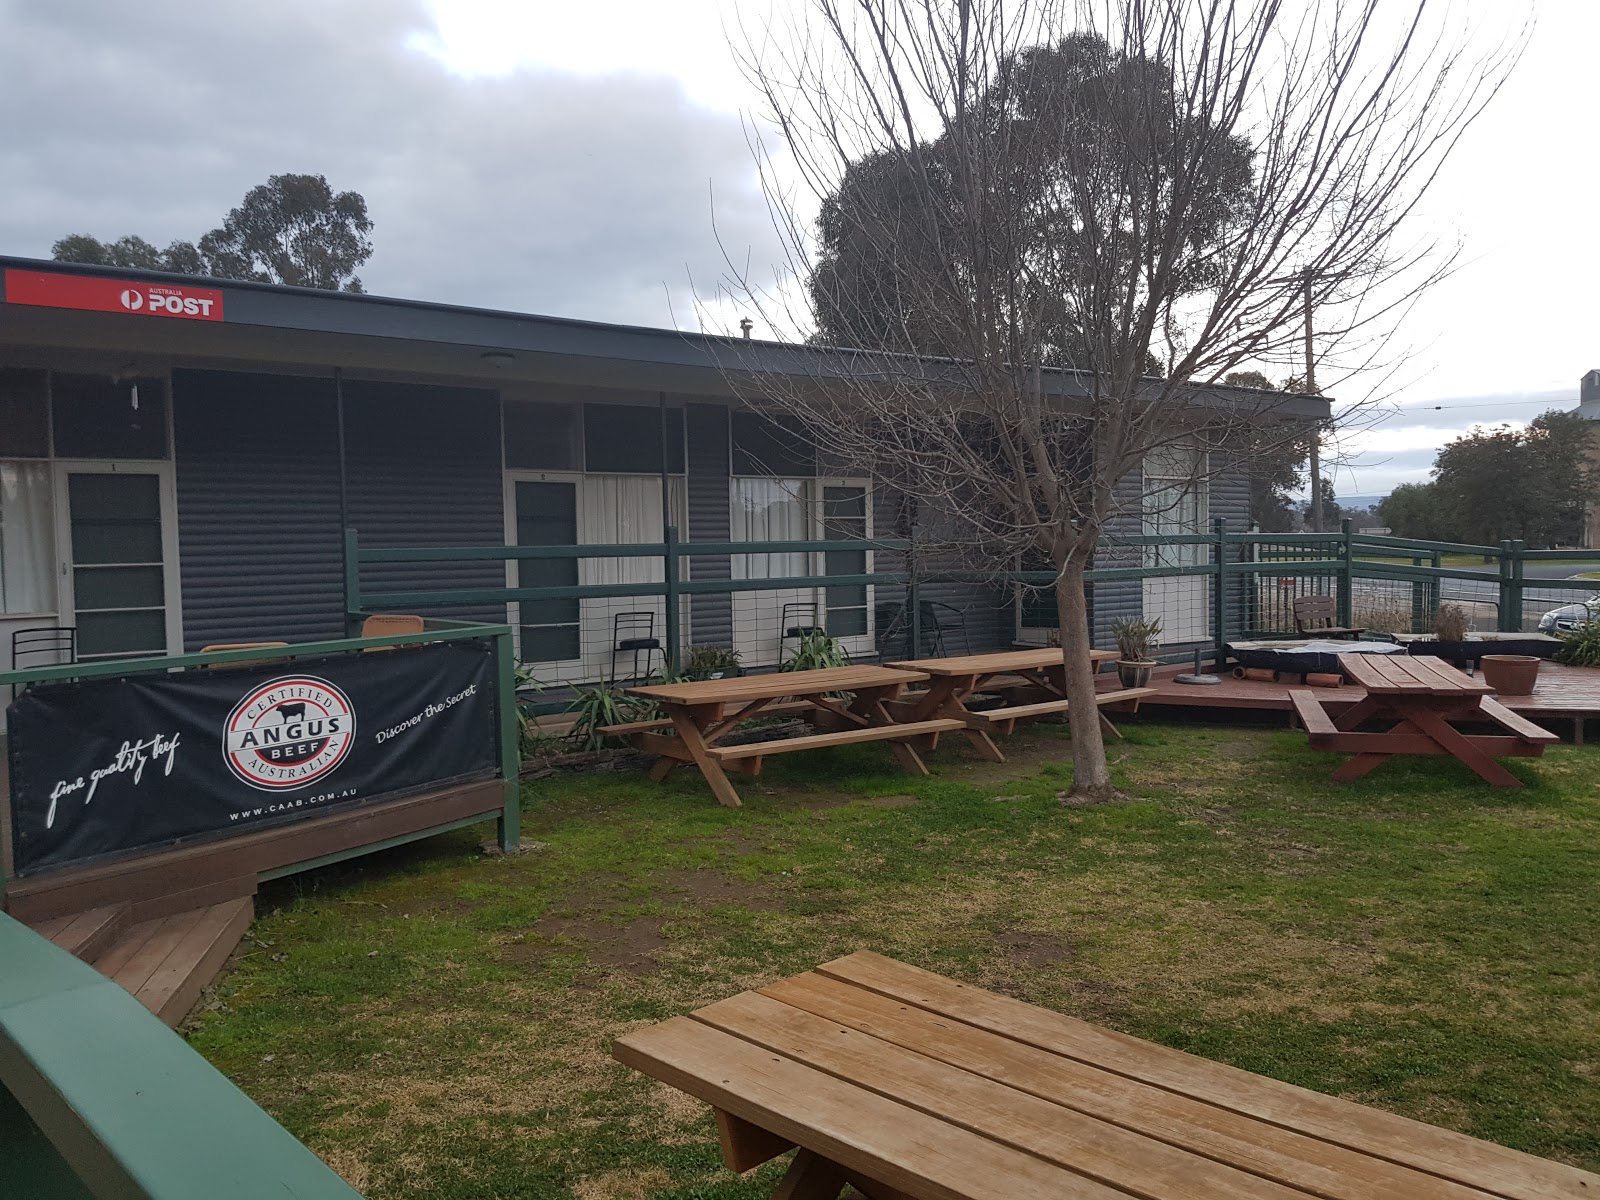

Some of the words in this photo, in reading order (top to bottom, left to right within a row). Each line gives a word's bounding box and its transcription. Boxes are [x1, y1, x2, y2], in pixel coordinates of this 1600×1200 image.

[149, 287, 183, 296] AUSTRALIA
[149, 294, 214, 316] POST
[247, 687, 333, 720] CERTIFIED
[375, 712, 423, 744] Discover
[424, 703, 445, 718] the
[446, 684, 477, 709] Secret
[240, 717, 340, 749] ANGUS
[248, 739, 340, 779] AUSTRALIAN
[271, 742, 319, 760] BEEF
[47, 777, 85, 829] fine
[85, 739, 148, 804] quality
[152, 732, 180, 776] beef
[229, 788, 357, 821] WWW.CAAB.COM.AU
